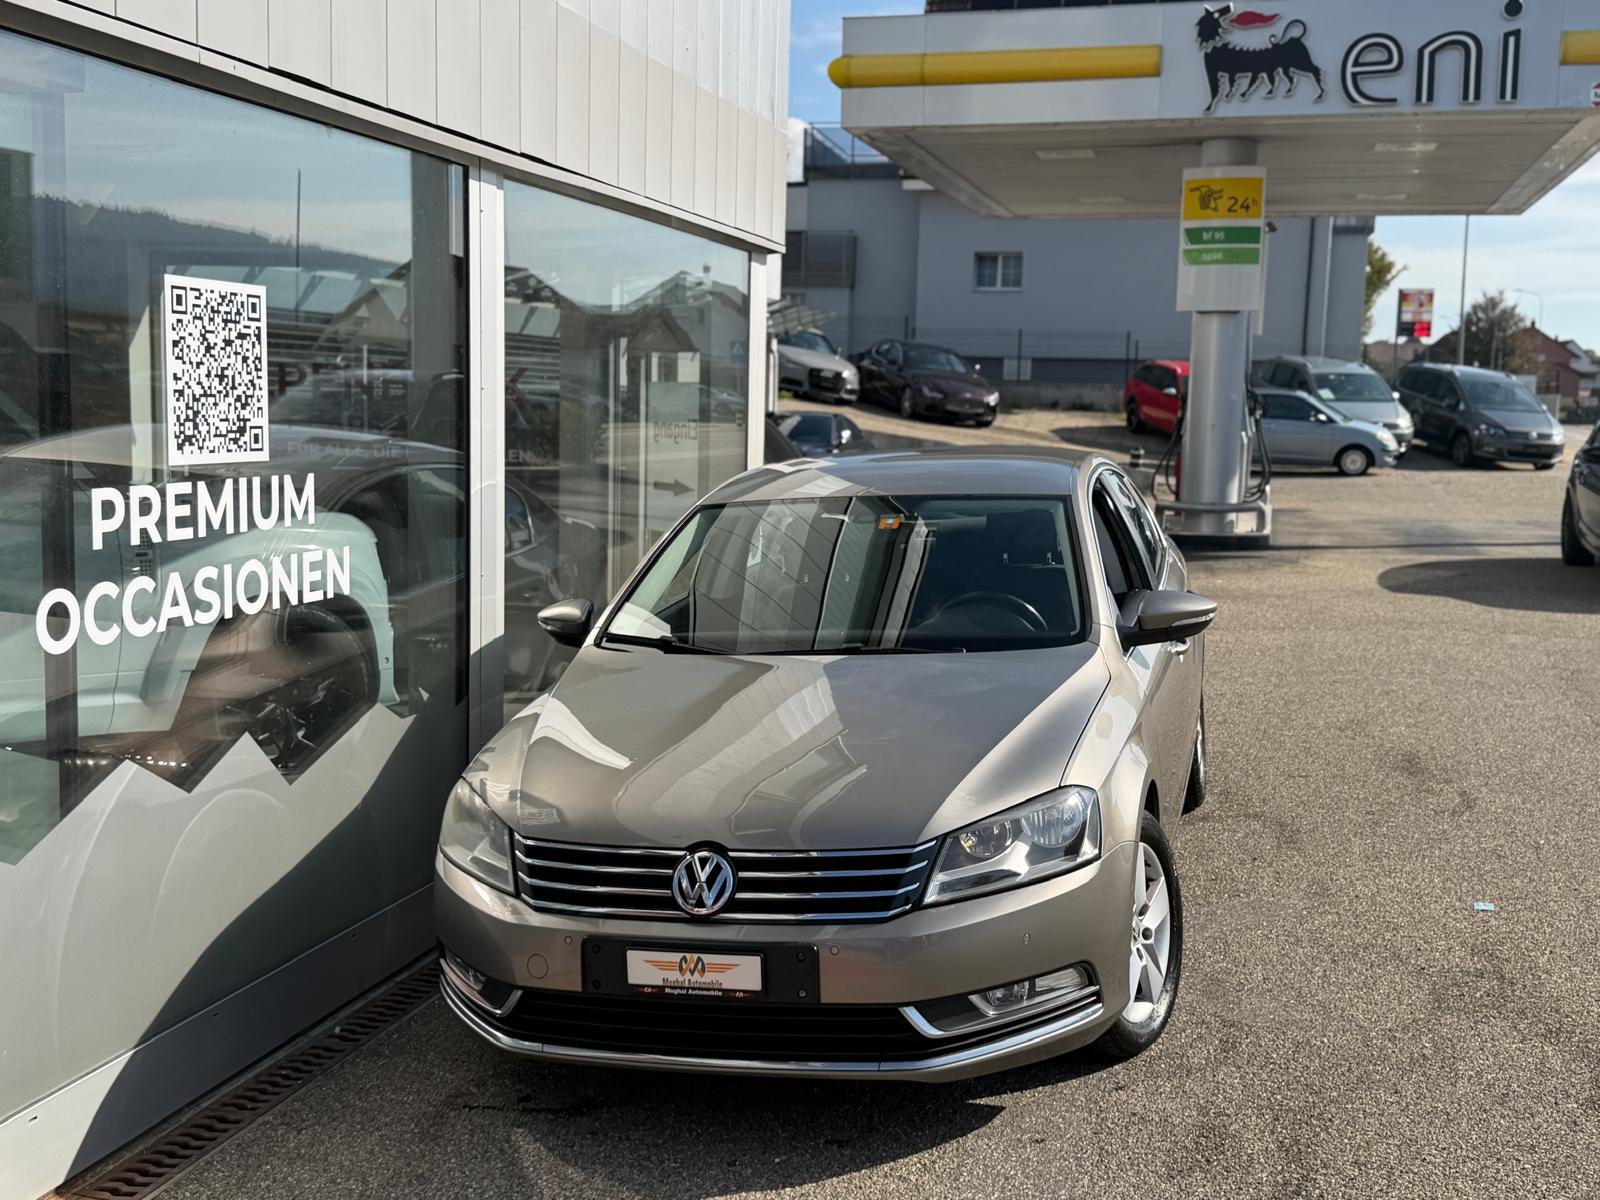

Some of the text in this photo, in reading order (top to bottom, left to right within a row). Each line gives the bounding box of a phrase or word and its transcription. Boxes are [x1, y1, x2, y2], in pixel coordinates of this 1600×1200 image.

[1341, 0, 1523, 106] eni
[91, 472, 315, 550] PREMIUM
[36, 545, 351, 655] OCCASIONEN
[688, 988, 722, 996] Automobile
